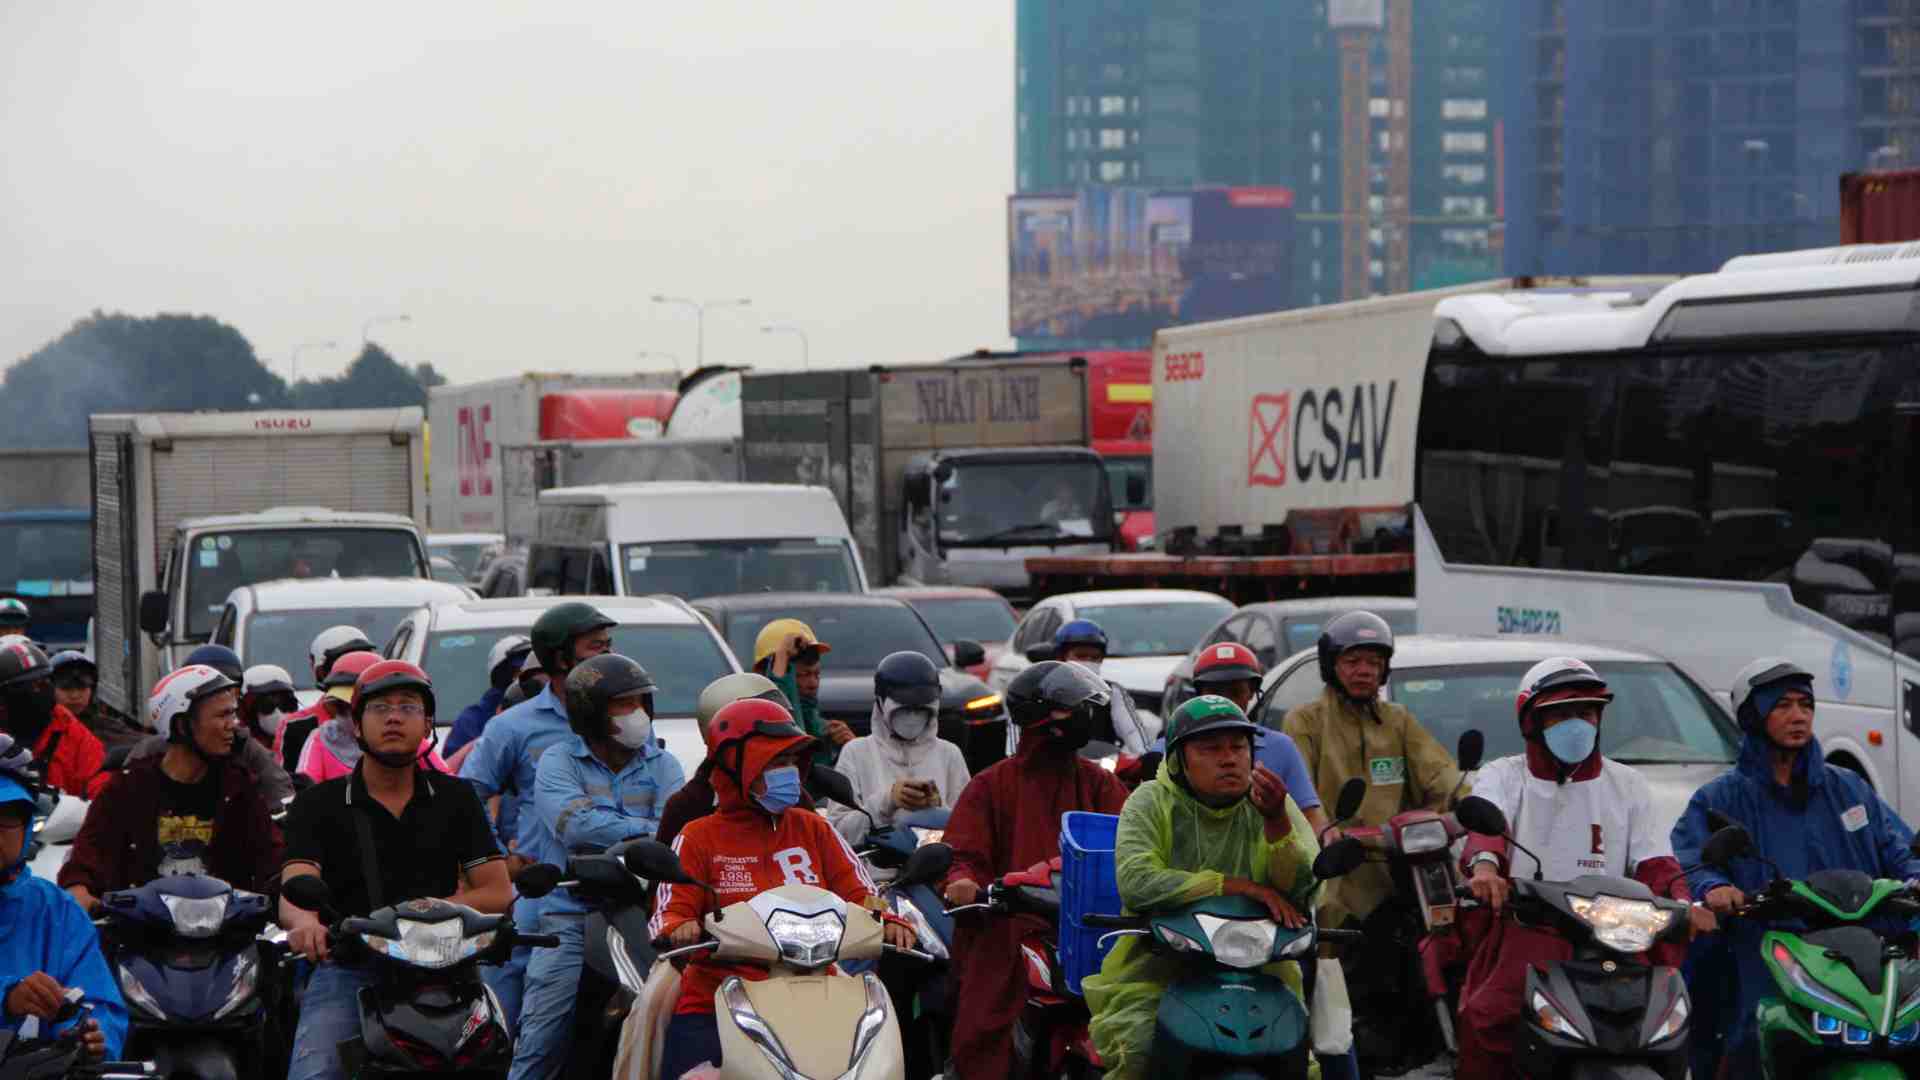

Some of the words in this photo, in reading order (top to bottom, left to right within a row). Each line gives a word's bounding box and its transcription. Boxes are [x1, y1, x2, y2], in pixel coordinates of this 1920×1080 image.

[254, 417, 312, 430] ISUZU
[1294, 379, 1397, 483] CSAV
[720, 871, 752, 882] 1986
[773, 846, 820, 886] R
